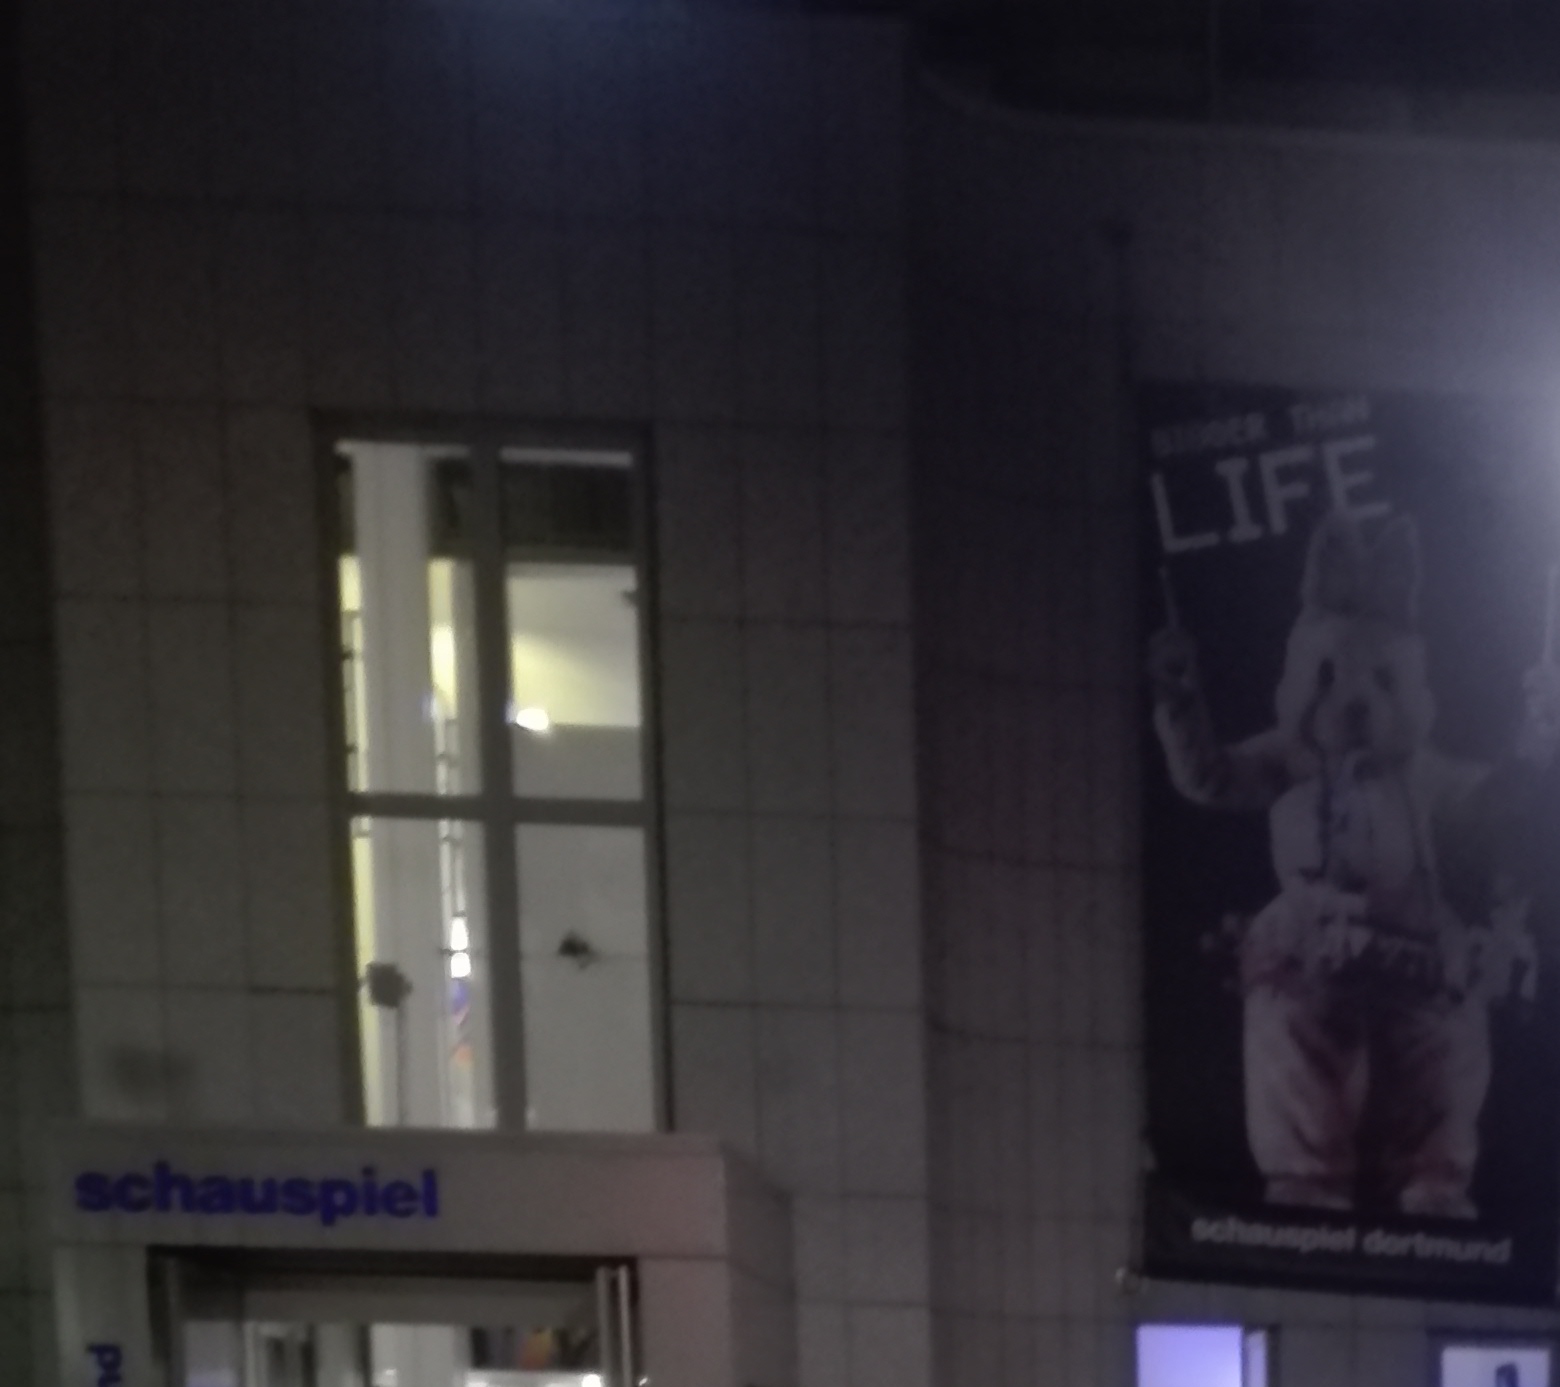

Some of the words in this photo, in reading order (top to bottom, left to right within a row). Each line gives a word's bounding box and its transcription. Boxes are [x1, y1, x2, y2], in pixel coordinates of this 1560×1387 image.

[1151, 434, 1390, 553] LIFE
[75, 1161, 439, 1226] schauspiel
[1191, 1215, 1357, 1254] schauspiel
[1362, 1227, 1513, 1265] dortmund
